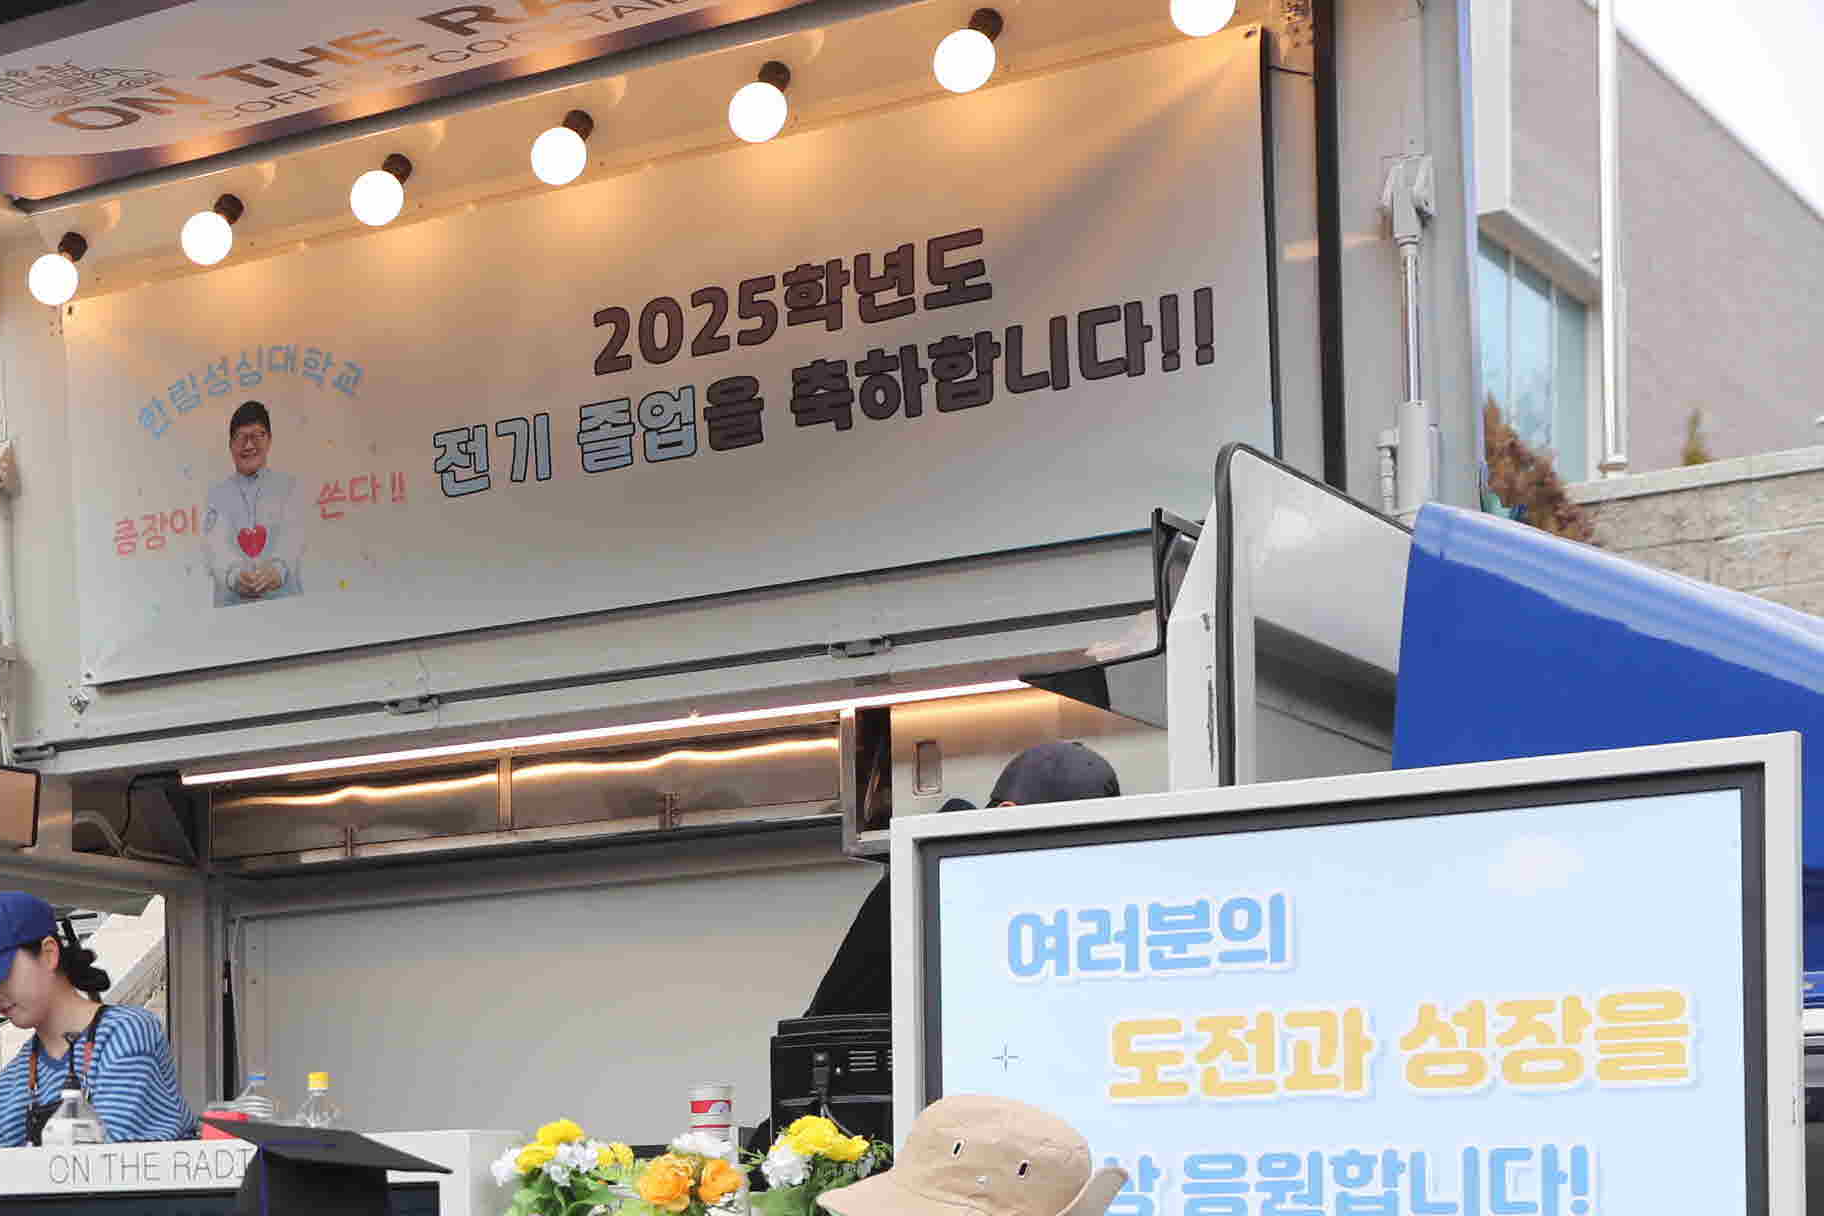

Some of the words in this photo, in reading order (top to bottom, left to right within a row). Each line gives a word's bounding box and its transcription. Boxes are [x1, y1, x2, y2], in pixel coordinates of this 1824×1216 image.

[49, 86, 209, 130] ON
[196, 28, 424, 89] THE
[592, 227, 994, 377] 2025학년도
[137, 343, 366, 440] 한림성심대학교
[433, 412, 553, 499] 전기
[576, 374, 765, 475] 졸업을
[788, 286, 1216, 432] 축하합니다!!
[113, 504, 201, 557] 총장이
[1006, 892, 1289, 977] 여러분의
[1108, 1007, 1373, 1100] 도전과
[1399, 990, 1691, 1092] 성장을
[47, 1154, 91, 1187] ON
[101, 1150, 162, 1184] THE
[173, 1146, 254, 1183] RADI
